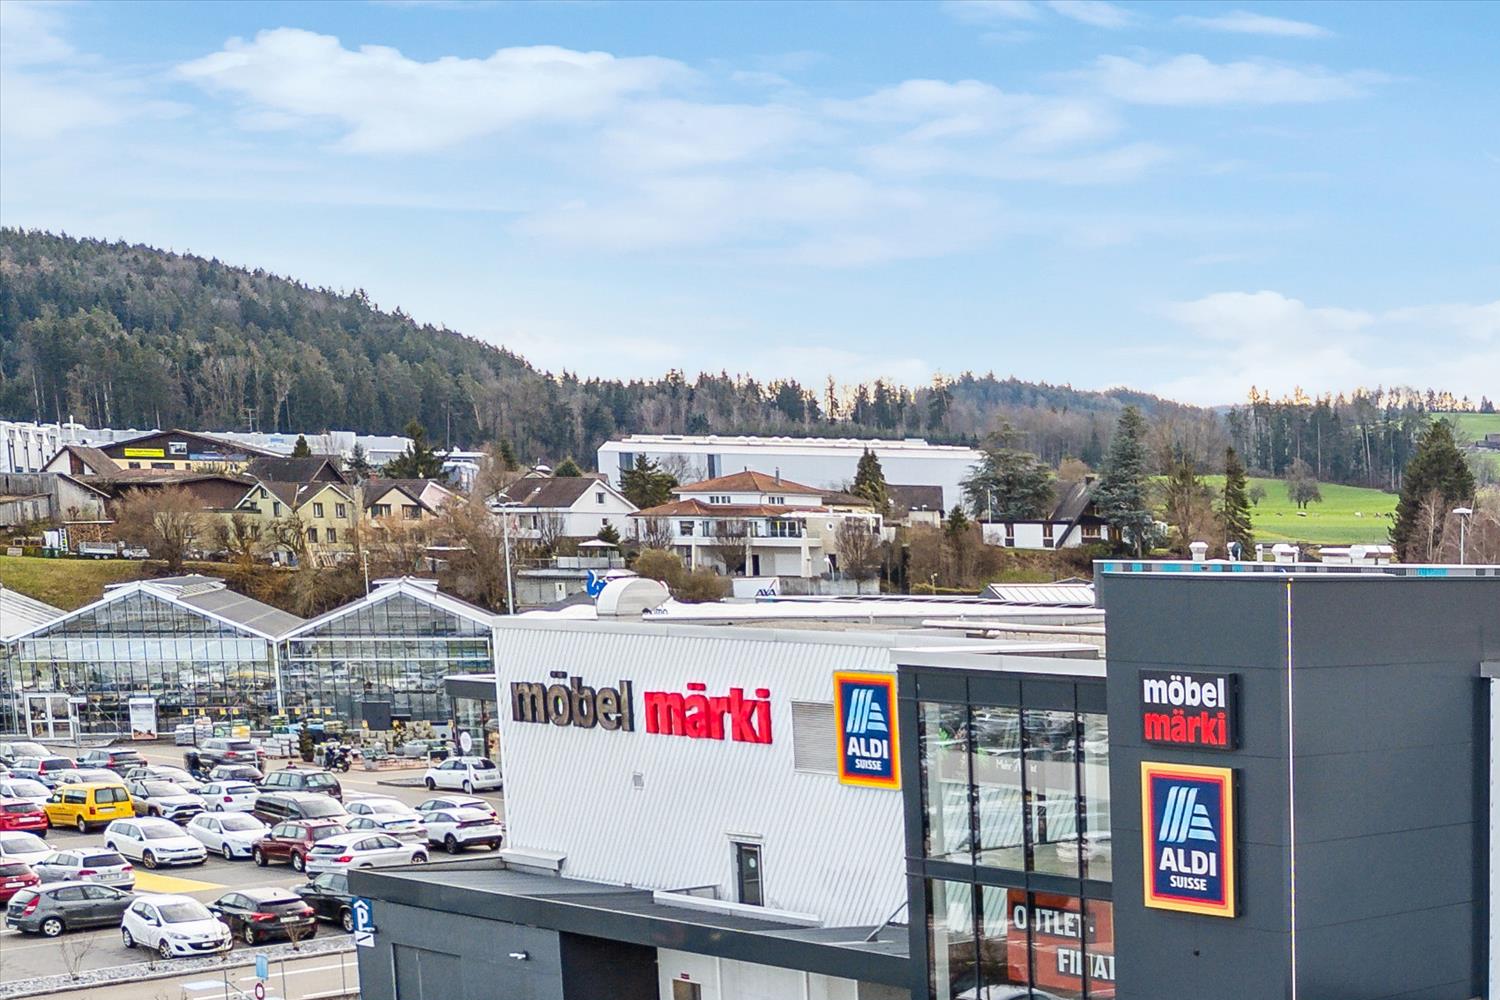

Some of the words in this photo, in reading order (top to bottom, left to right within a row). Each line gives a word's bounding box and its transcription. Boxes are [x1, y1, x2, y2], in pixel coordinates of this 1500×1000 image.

[1142, 674, 1226, 708] möbel
[510, 670, 635, 732] möbel
[644, 682, 773, 744] märki
[1143, 708, 1228, 746] märki
[846, 735, 889, 759] ALDI
[854, 758, 883, 771] SUISSE
[1158, 846, 1217, 877] ALDI
[1169, 875, 1208, 892] SUISSE
